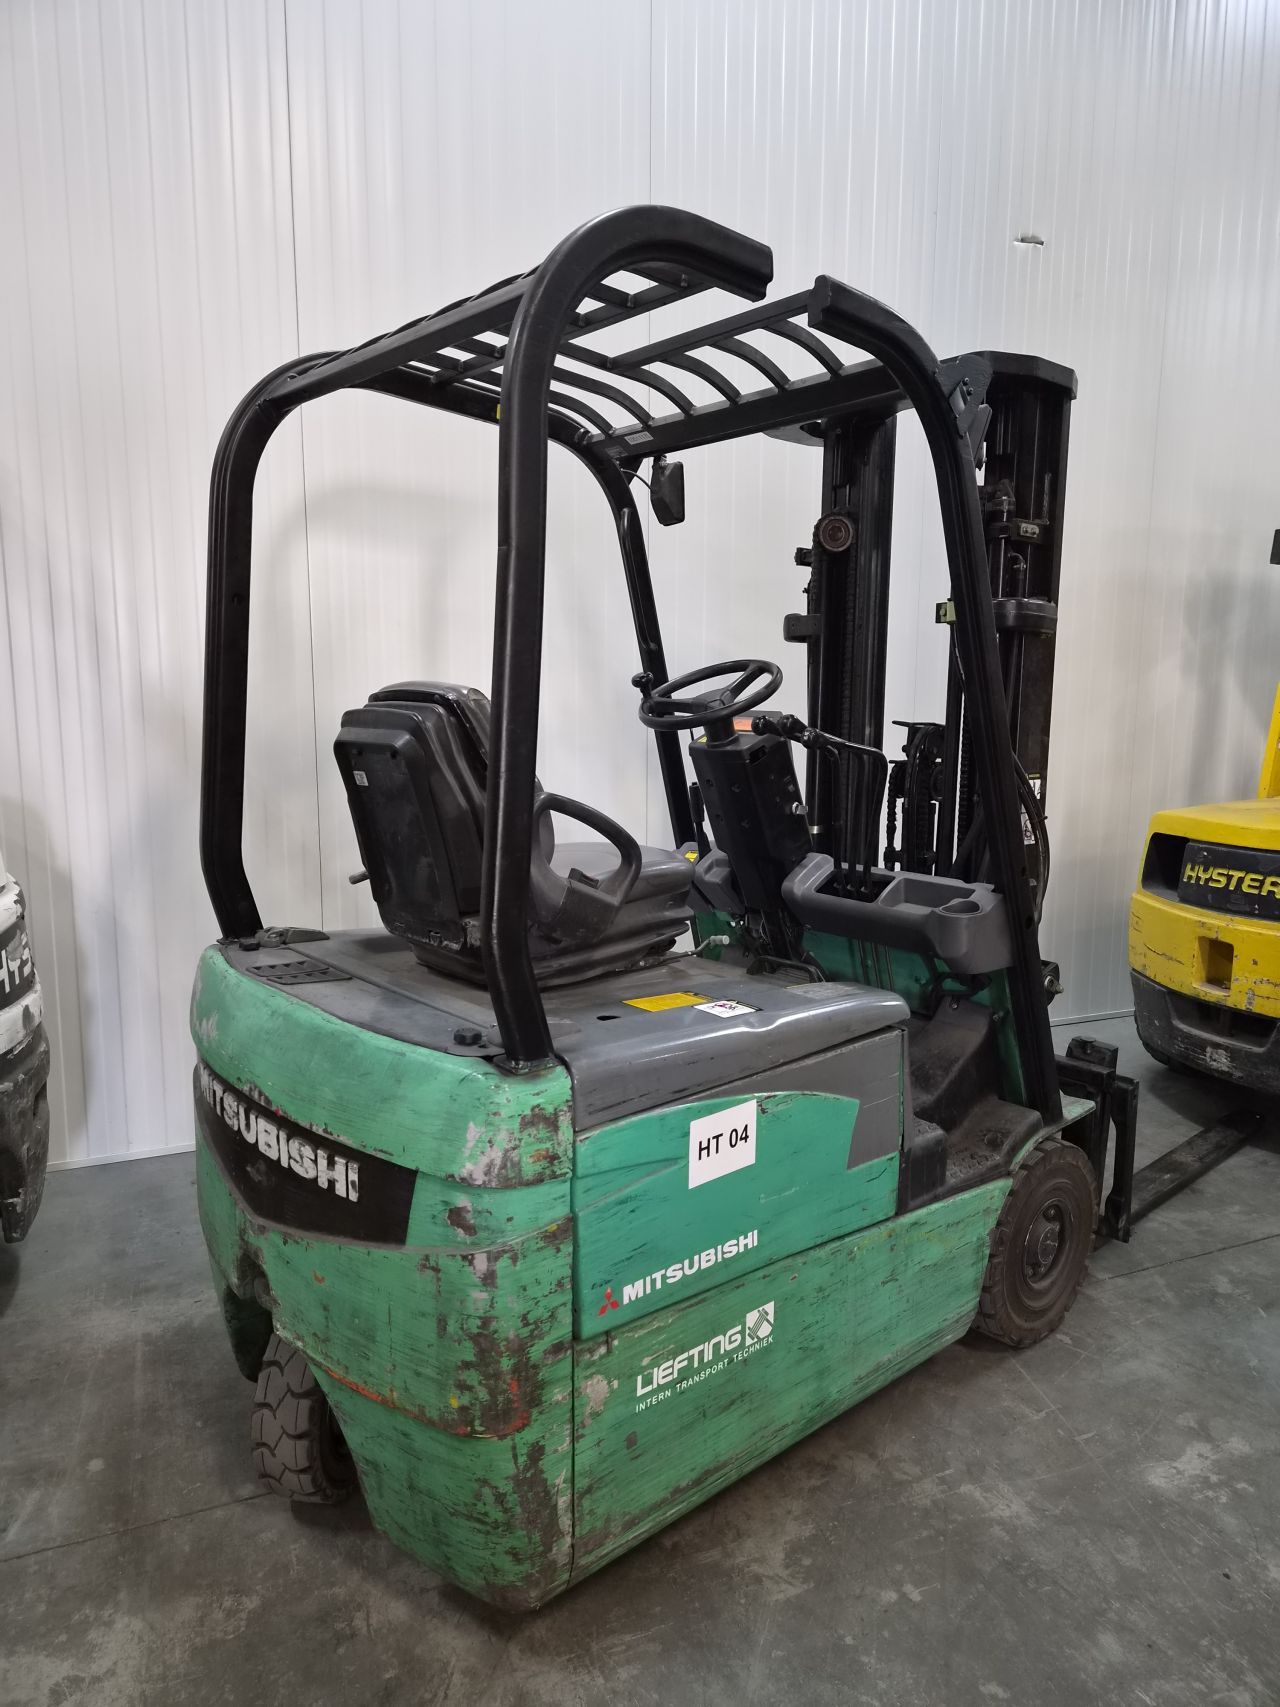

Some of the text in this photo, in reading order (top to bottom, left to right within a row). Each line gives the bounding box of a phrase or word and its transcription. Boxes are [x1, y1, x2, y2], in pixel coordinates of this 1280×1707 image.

[1183, 863, 1280, 899] HYSTER
[198, 1063, 359, 1202] MITSUBISHI
[698, 1124, 749, 1160] HT 04
[623, 1230, 758, 1305] MITSUBISHI
[635, 1335, 774, 1413] INTERN TRANSPORT TECHNIEK
[636, 1325, 741, 1397] LIEFTING
